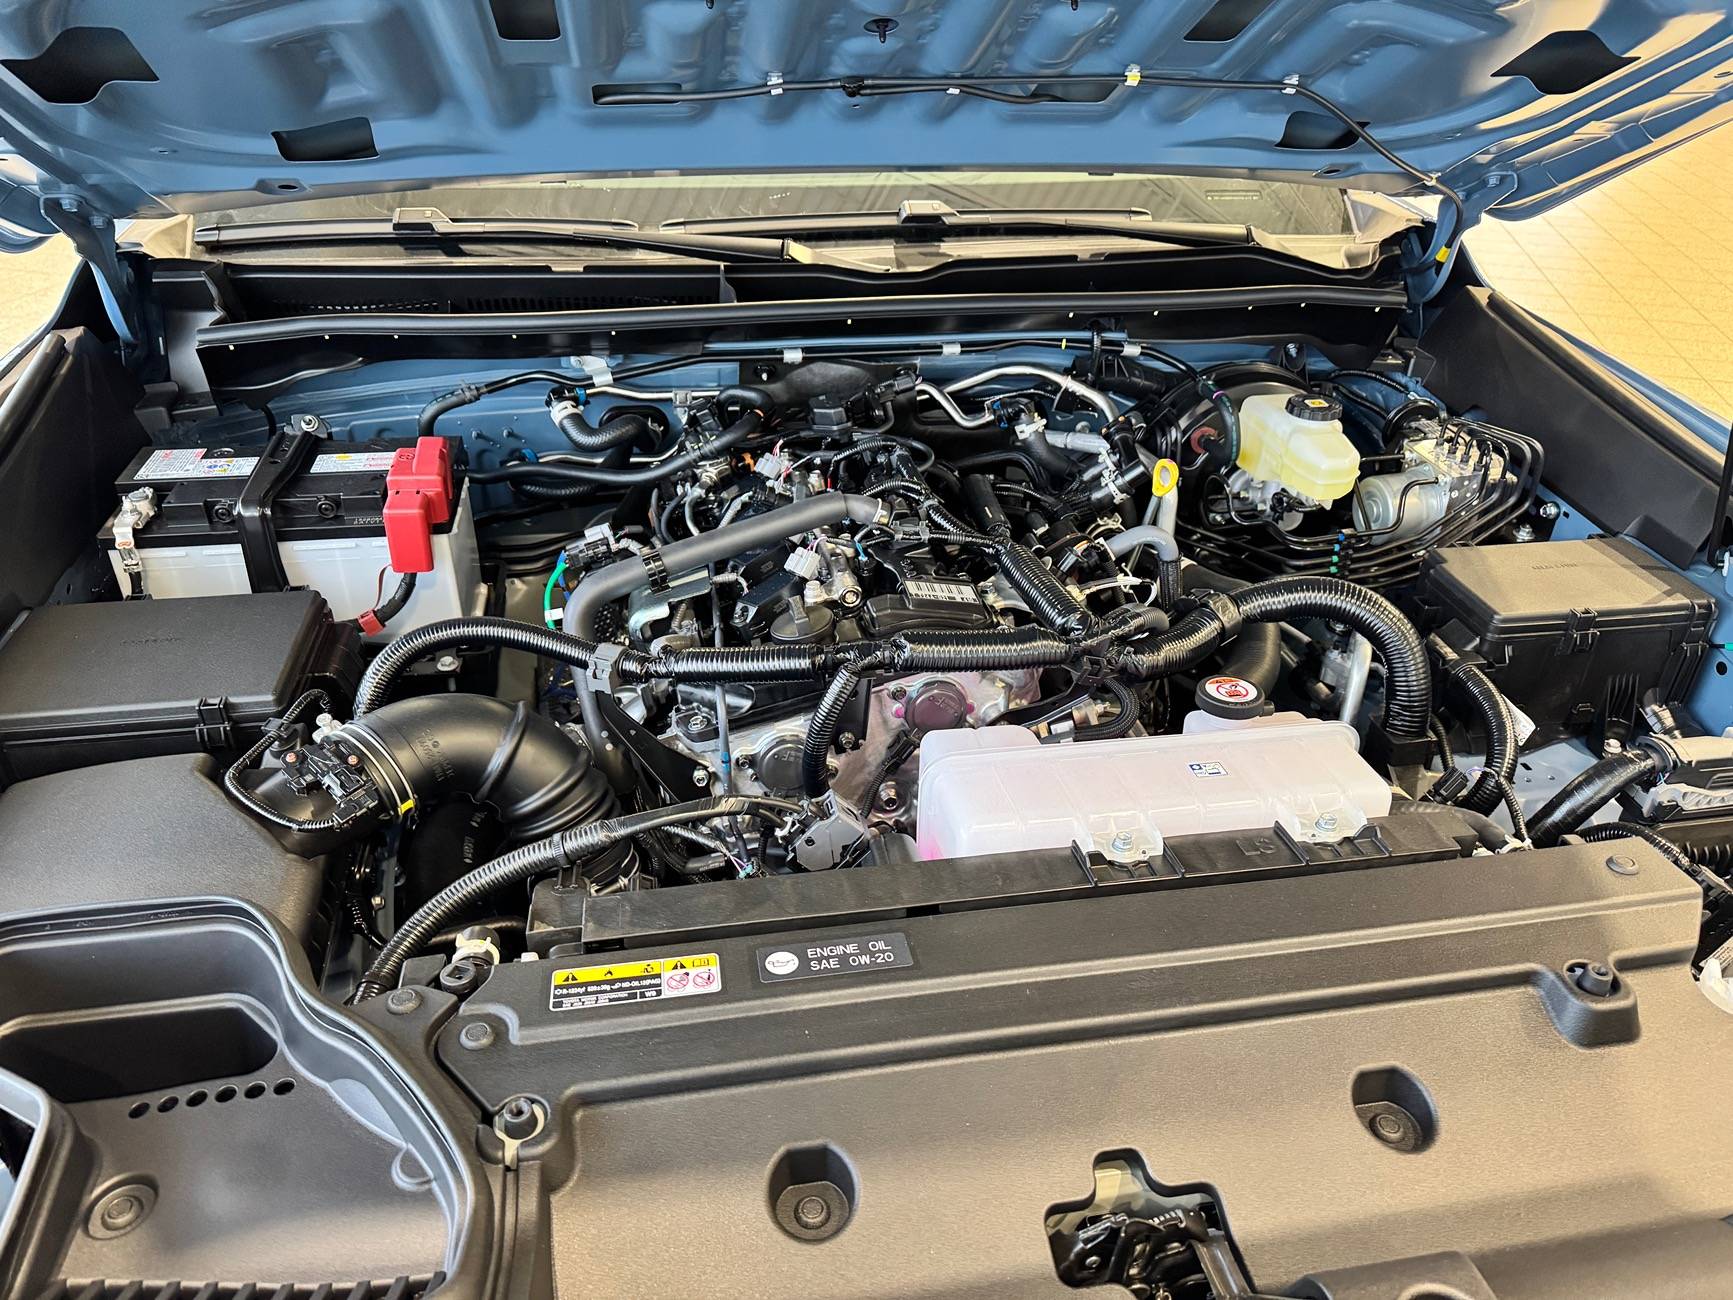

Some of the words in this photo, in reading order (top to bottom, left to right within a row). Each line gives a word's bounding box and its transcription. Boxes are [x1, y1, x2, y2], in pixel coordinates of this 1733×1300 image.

[807, 943, 860, 959] ENGINE
[868, 940, 892, 952] OIL
[810, 958, 841, 971] SAE
[849, 952, 894, 966] 0W-20
